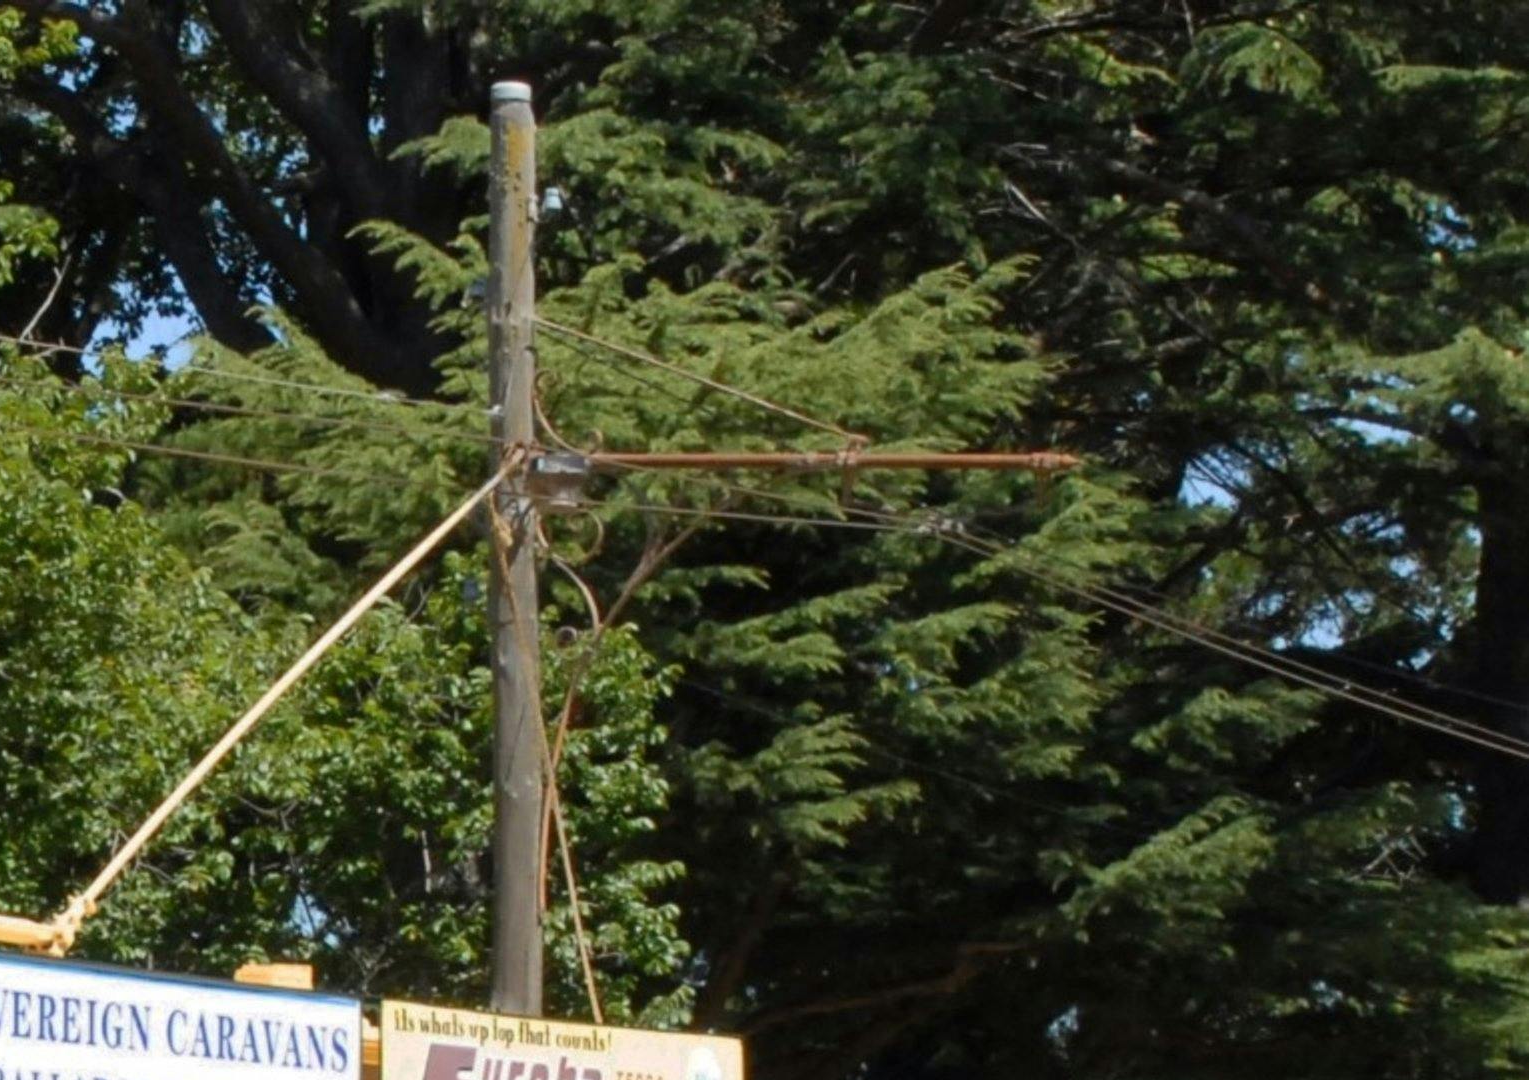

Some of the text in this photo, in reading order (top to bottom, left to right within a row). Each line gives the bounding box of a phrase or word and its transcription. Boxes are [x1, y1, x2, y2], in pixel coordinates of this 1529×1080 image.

[166, 1008, 349, 1074] CARAVANS
[469, 1023, 489, 1046] up
[519, 1021, 551, 1046] that
